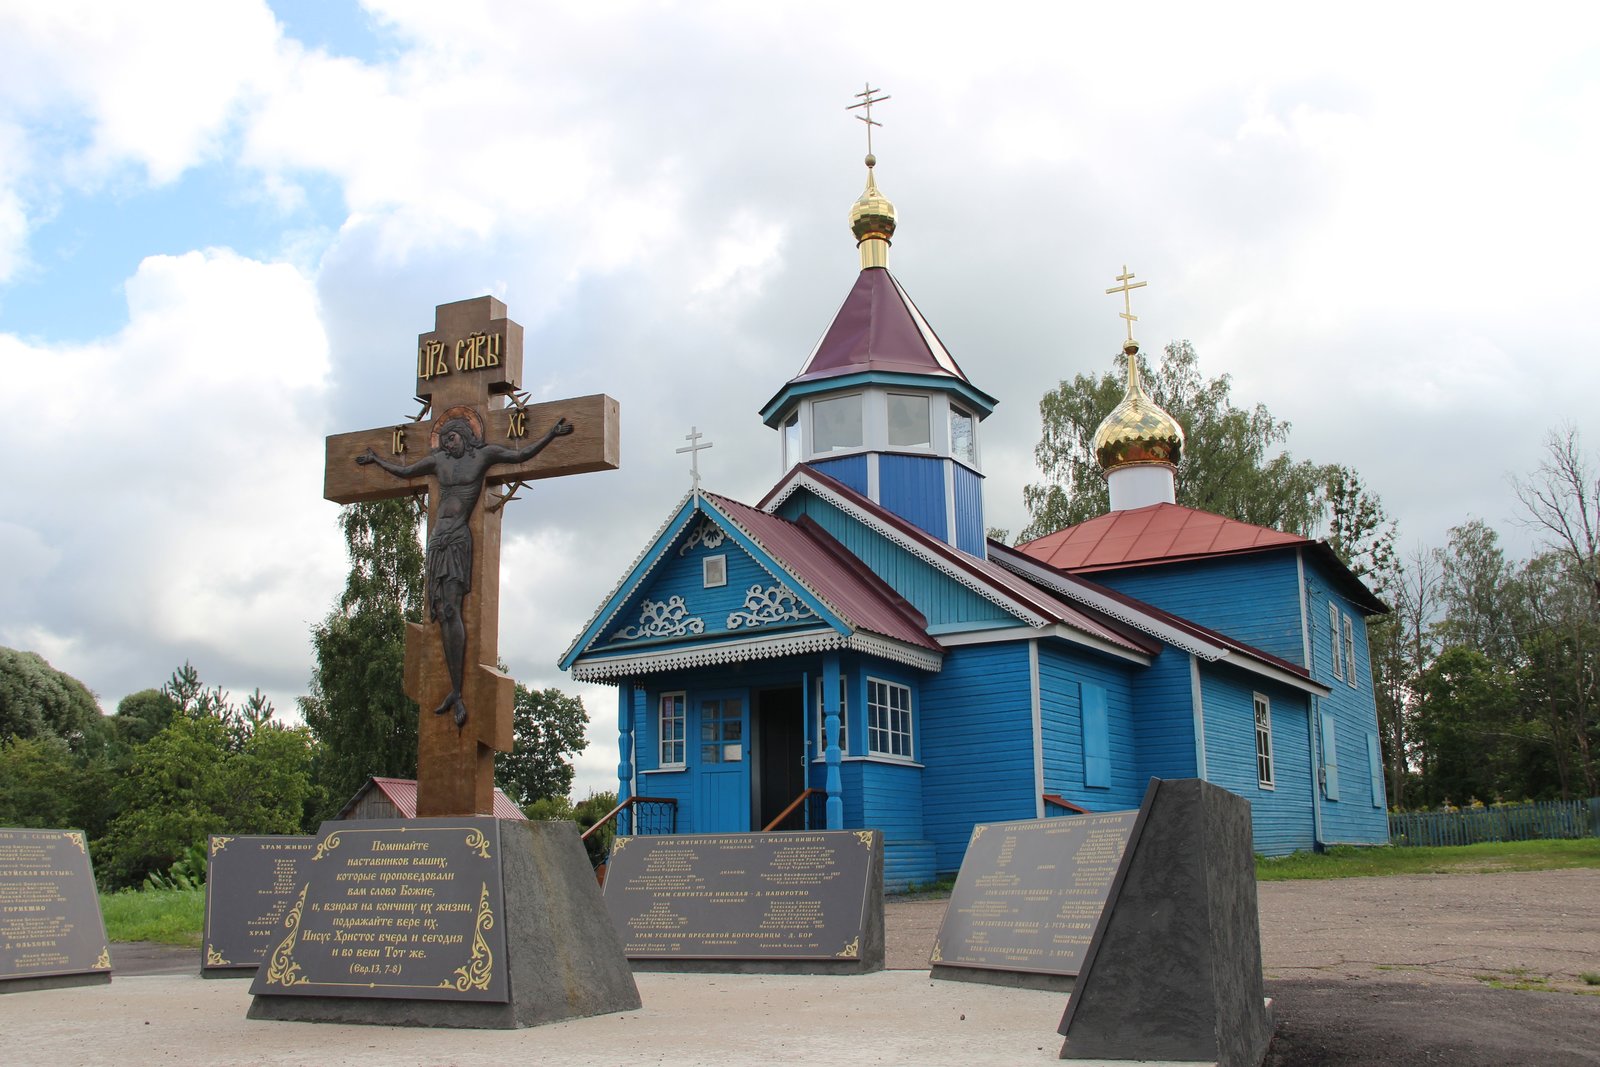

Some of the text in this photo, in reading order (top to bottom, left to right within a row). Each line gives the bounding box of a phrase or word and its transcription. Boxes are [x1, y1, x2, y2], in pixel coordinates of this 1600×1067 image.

[371, 841, 430, 851] Поминайте
[347, 857, 448, 868] наставников ваших,
[336, 872, 456, 884] которые проповедовали
[347, 885, 436, 897] вам слово Божие,
[312, 903, 473, 914] и, взирая на кончину их жизни,
[332, 916, 439, 930] подражайте вере их.
[303, 930, 463, 945] Иисус Христос вчера и сегодня
[332, 946, 427, 958] и во веки Тот же.
[384, 963, 402, 975] 7-8)
